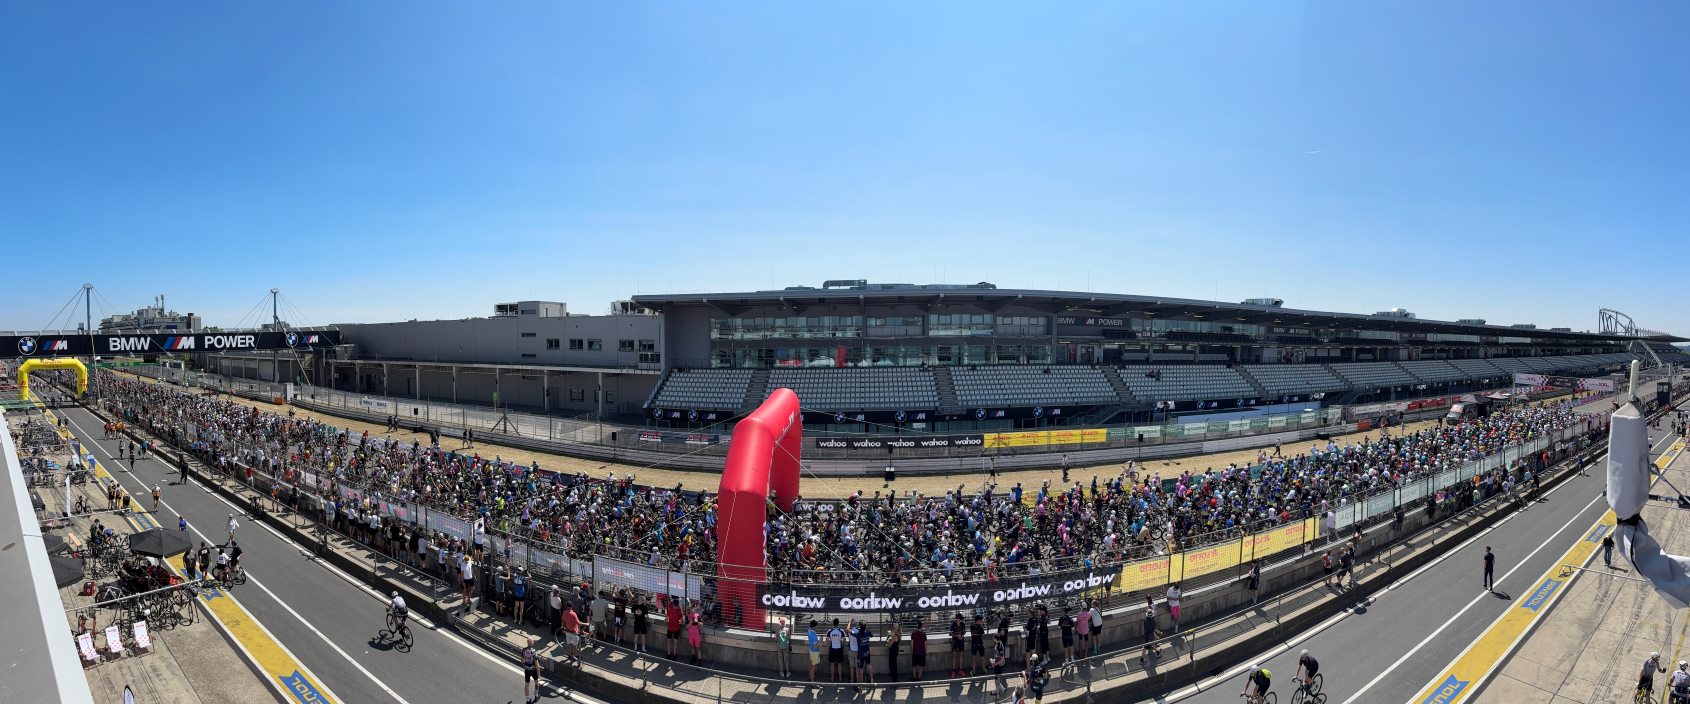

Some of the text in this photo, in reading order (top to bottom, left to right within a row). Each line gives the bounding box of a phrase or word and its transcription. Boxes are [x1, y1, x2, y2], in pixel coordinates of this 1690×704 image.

[1057, 317, 1075, 325] BMW
[1098, 318, 1123, 326] POWER
[109, 337, 150, 351] BMW
[204, 335, 255, 349] POWER
[819, 439, 847, 448] wahoo
[853, 439, 881, 448] wahoo
[921, 438, 949, 446] wahoo
[954, 437, 982, 445] wahoo
